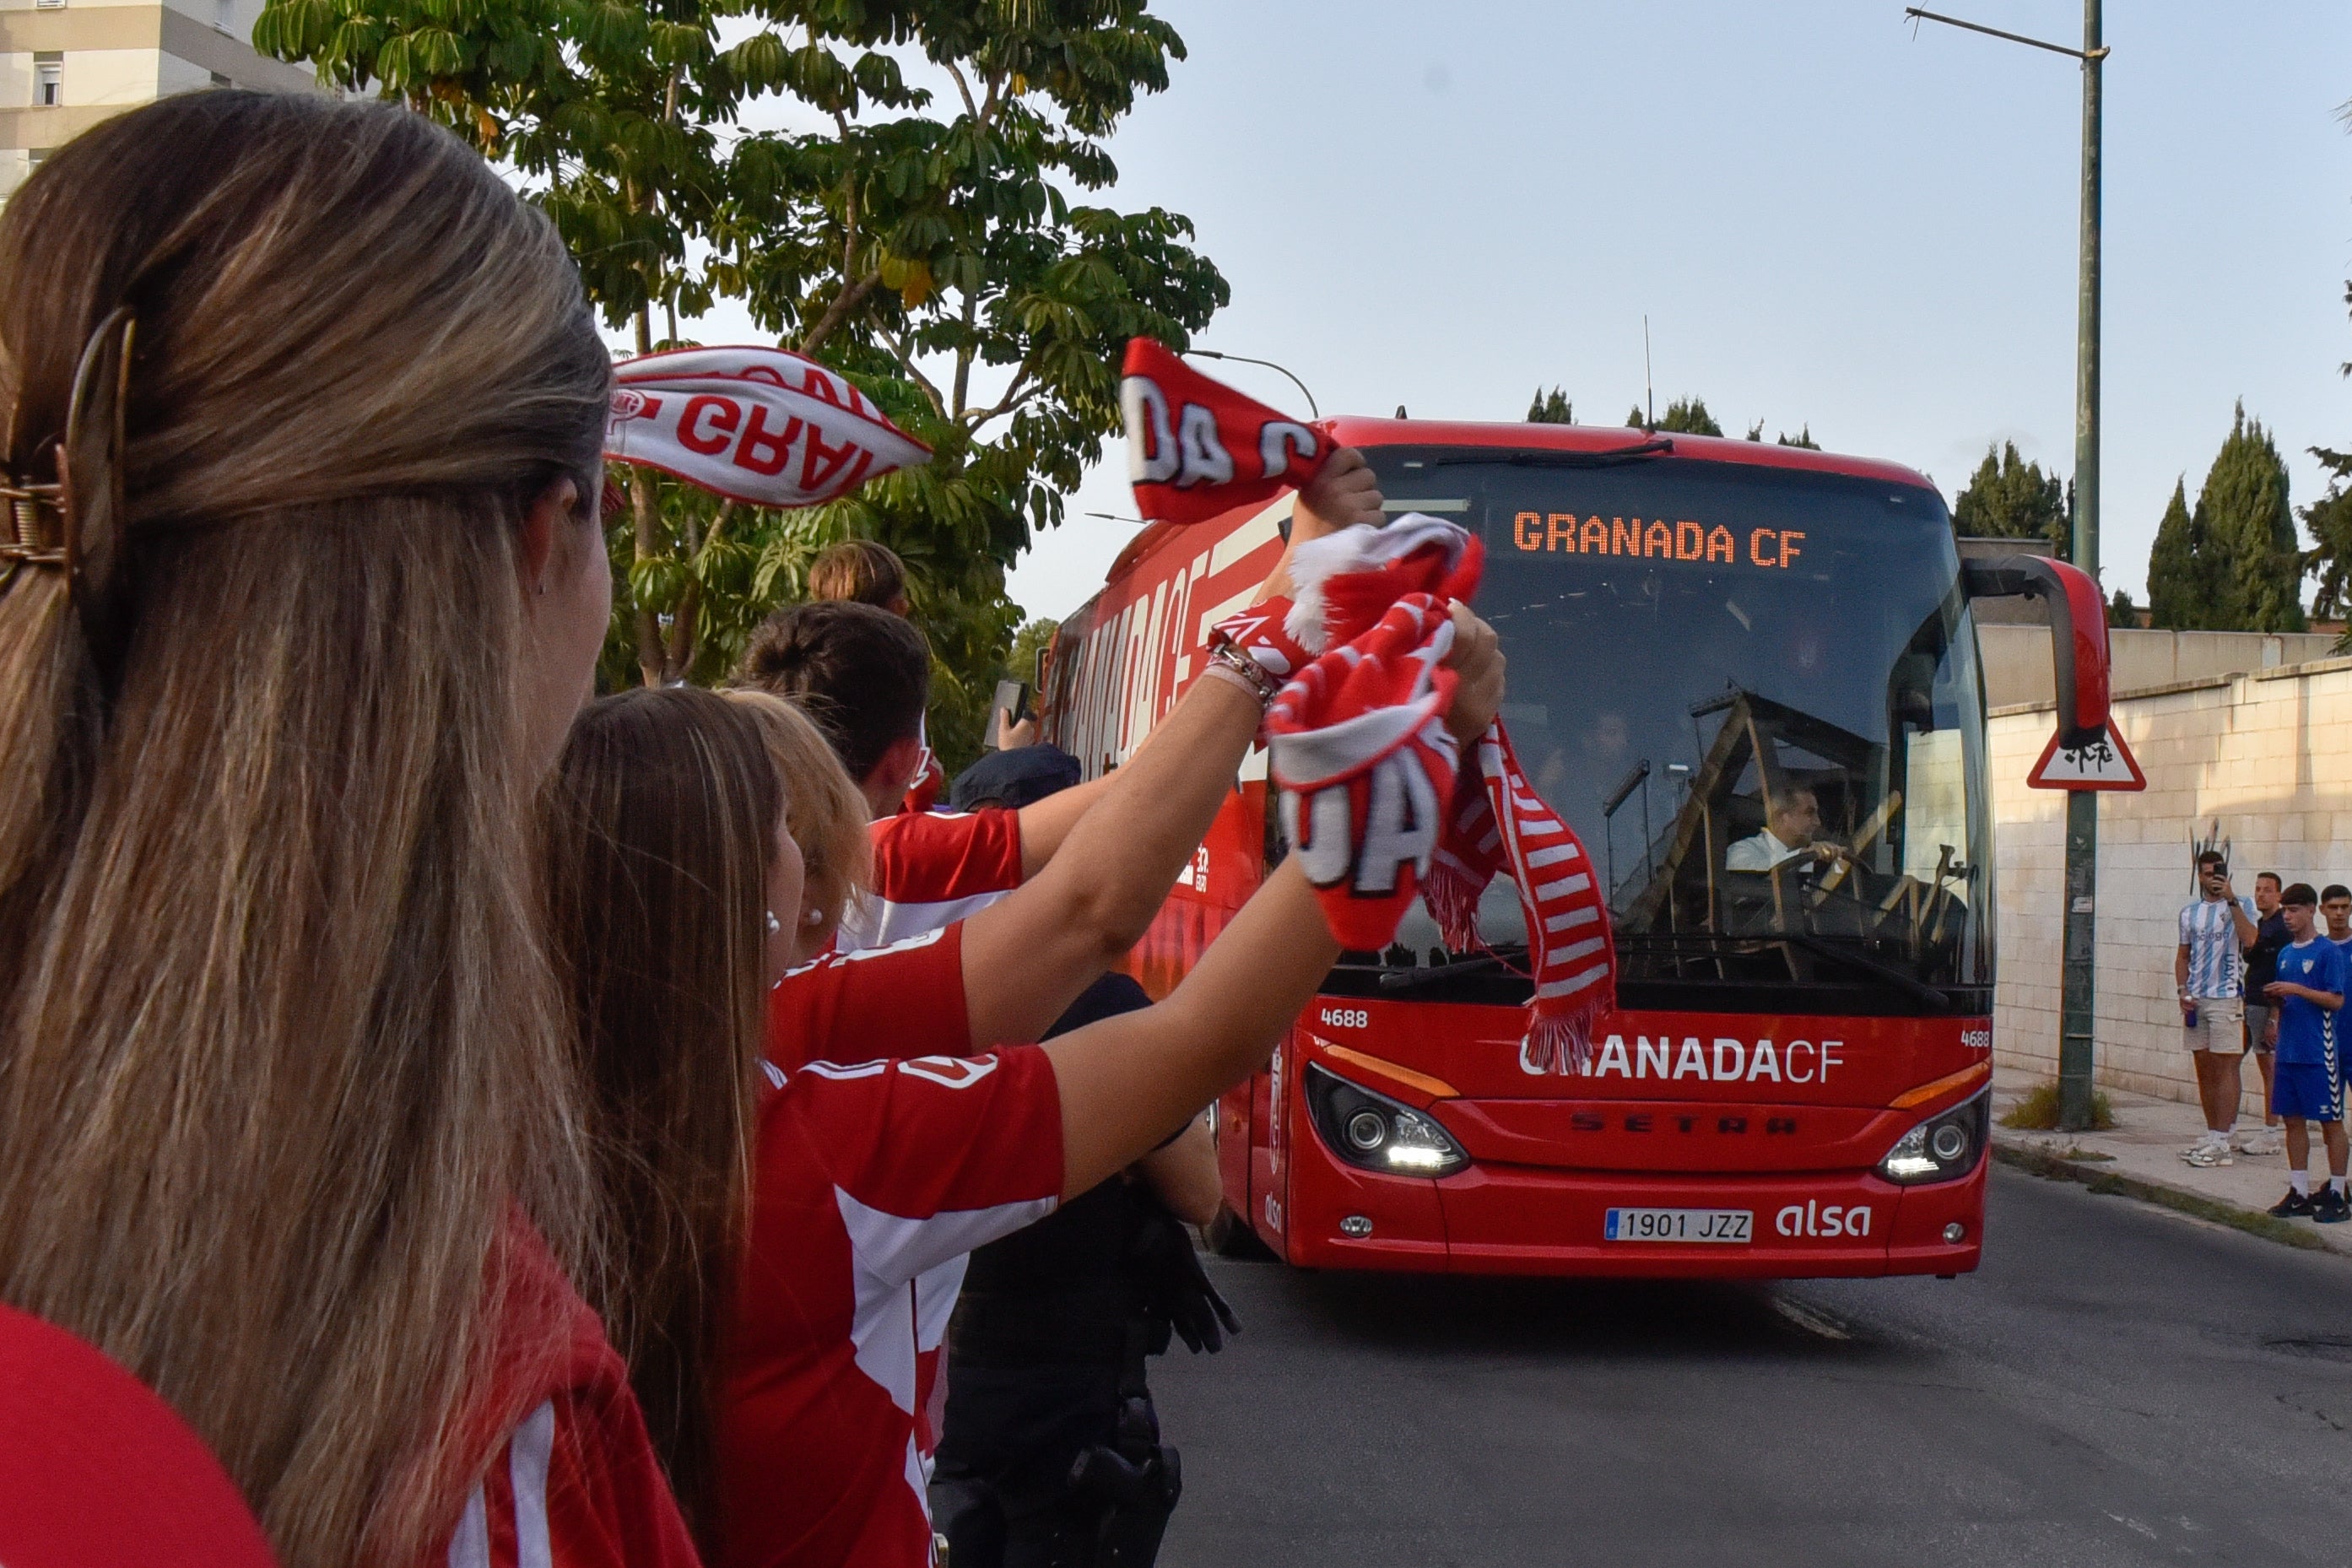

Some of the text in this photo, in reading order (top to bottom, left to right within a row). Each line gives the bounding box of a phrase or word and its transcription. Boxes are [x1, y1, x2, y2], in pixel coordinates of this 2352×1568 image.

[1513, 511, 1806, 569] GRANADA CF
[1321, 1008, 1368, 1029] 4688
[1960, 1030, 1990, 1048] 4688
[1571, 1112, 1797, 1134] SETRA
[1627, 1213, 1749, 1239] 1901 JZZ
[1776, 1199, 1871, 1237] alsa
